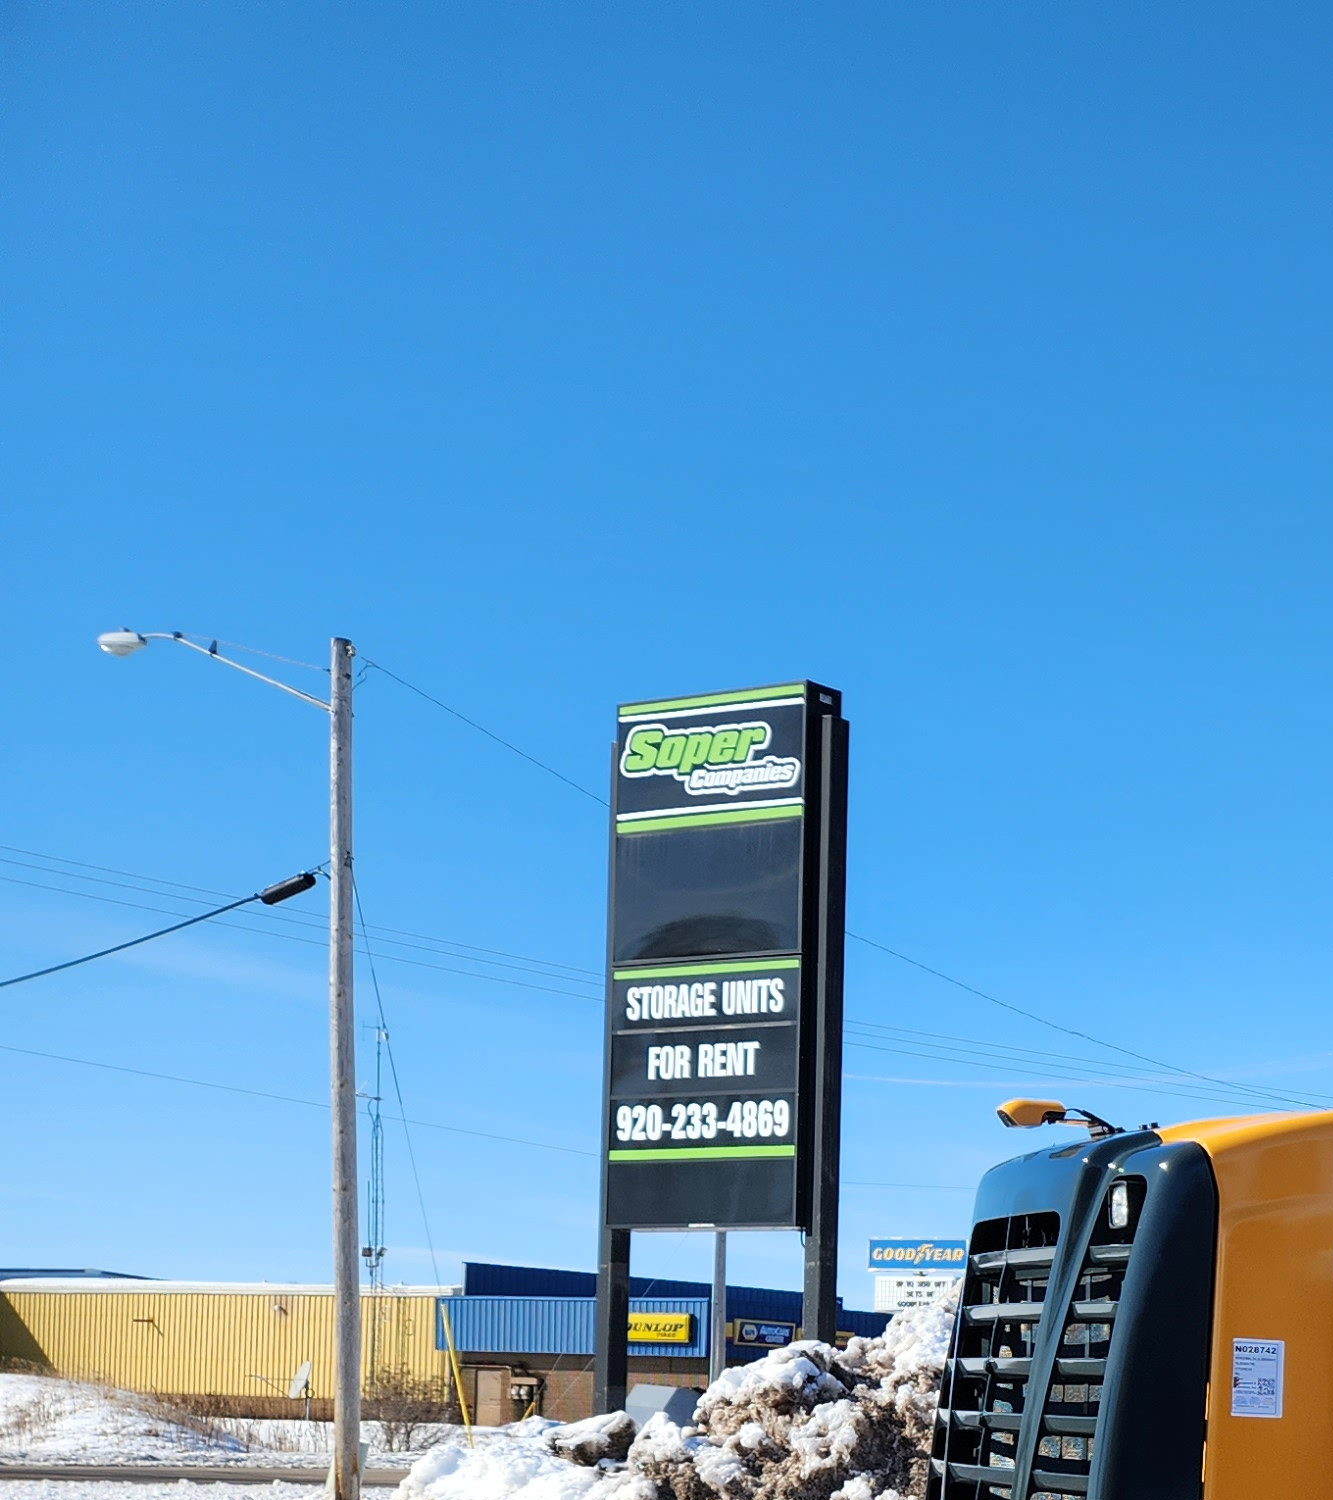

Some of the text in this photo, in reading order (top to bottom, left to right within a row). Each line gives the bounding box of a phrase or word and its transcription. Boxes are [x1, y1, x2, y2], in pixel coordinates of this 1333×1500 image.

[623, 725, 769, 775] Soper
[689, 762, 797, 789] Companies
[626, 978, 784, 1021] STORAGE UNITS
[647, 1041, 760, 1080] FOR RENT
[616, 1099, 789, 1141] 920-233-4869
[872, 1246, 965, 1263] GOODYEAR
[1235, 1345, 1277, 1354] N028742
